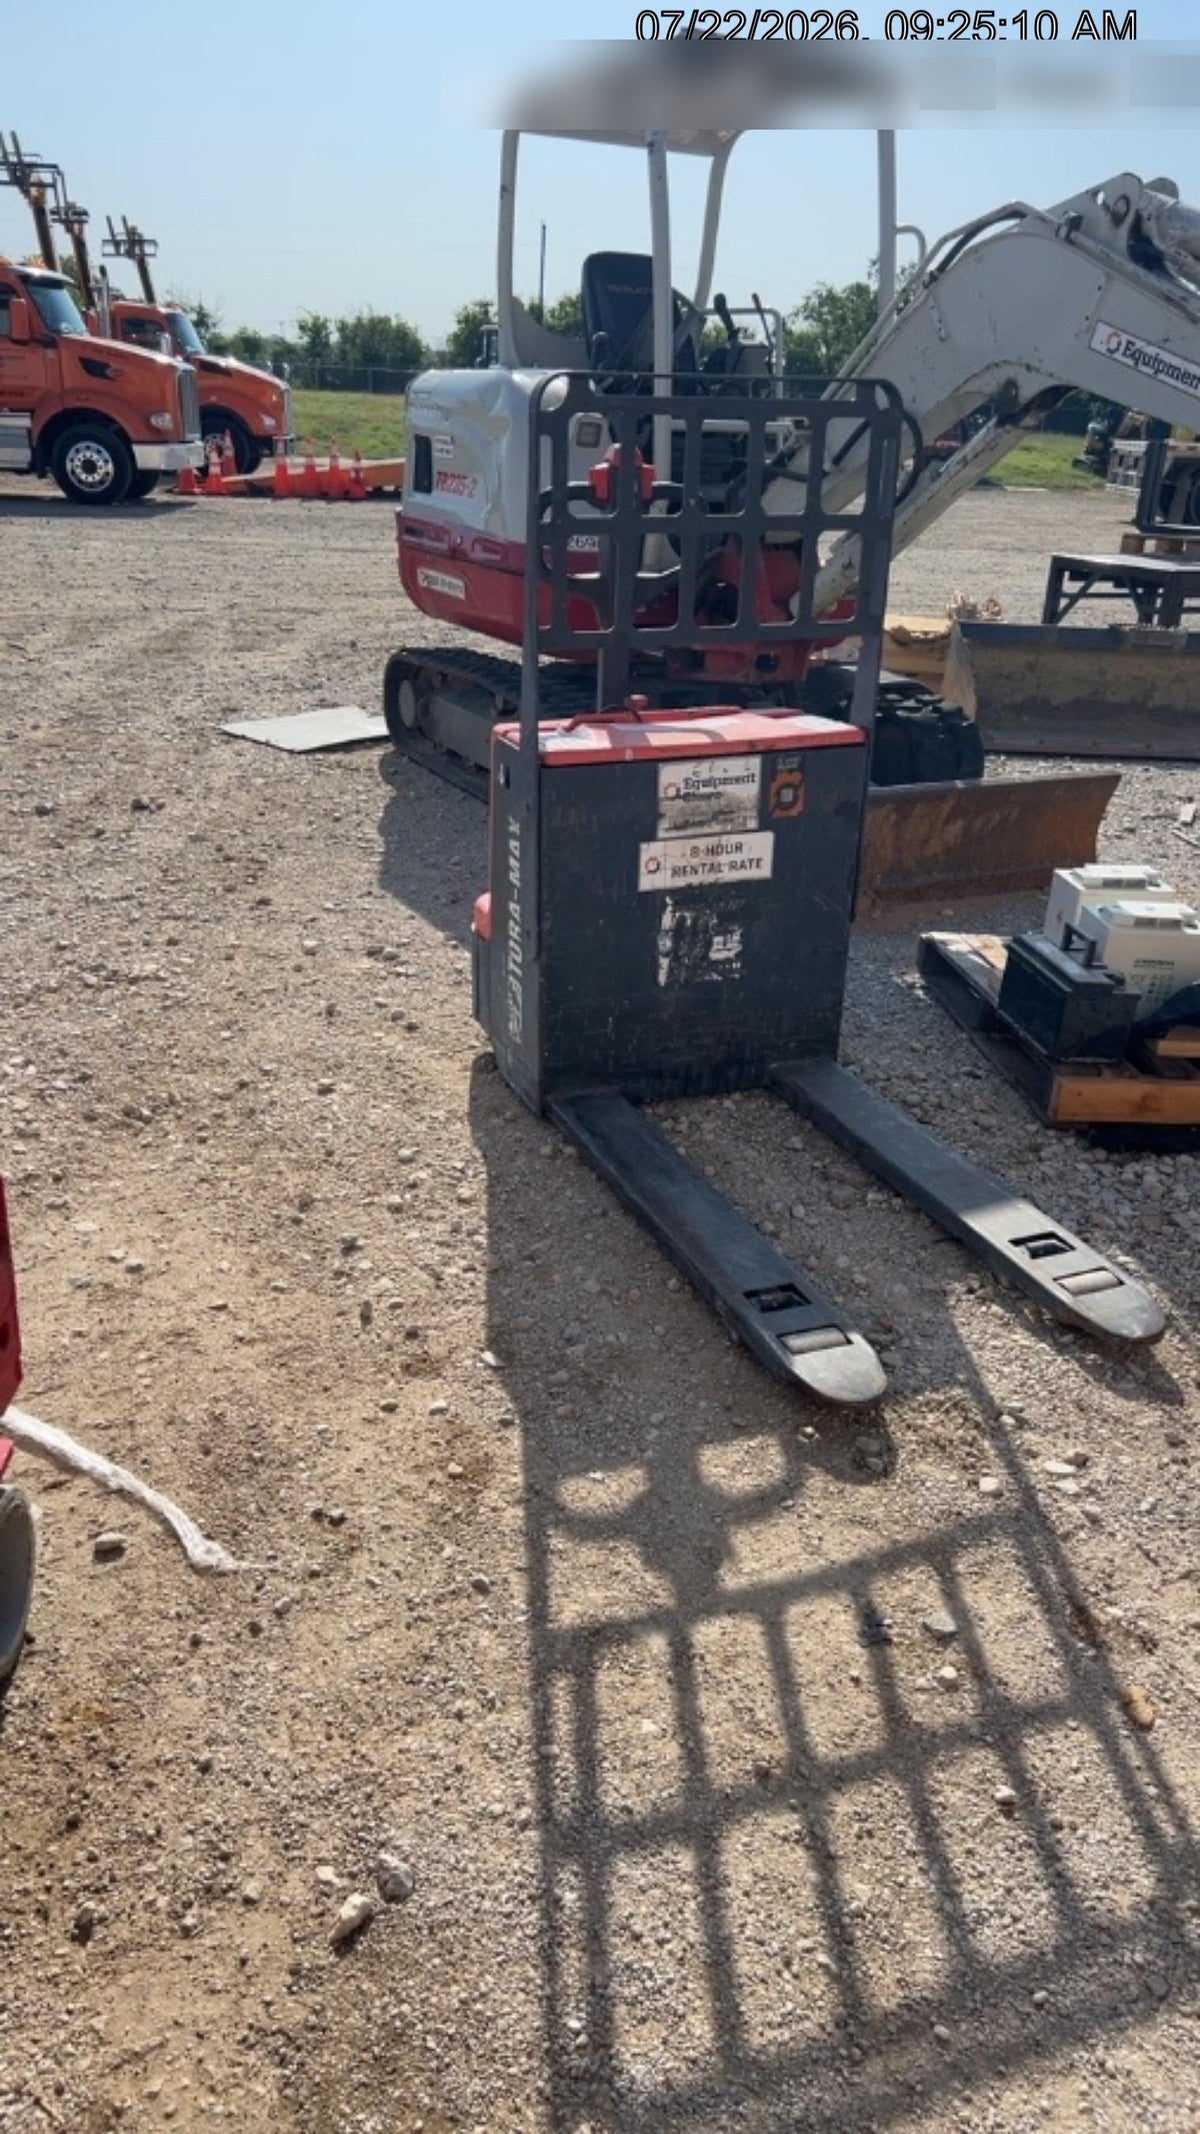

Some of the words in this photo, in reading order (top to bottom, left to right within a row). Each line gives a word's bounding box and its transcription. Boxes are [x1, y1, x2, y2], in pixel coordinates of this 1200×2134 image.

[683, 772, 756, 791] Equipment
[689, 841, 744, 858] 8-HOUR
[671, 861, 723, 878] RENTAL
[728, 857, 764, 872] RATE
